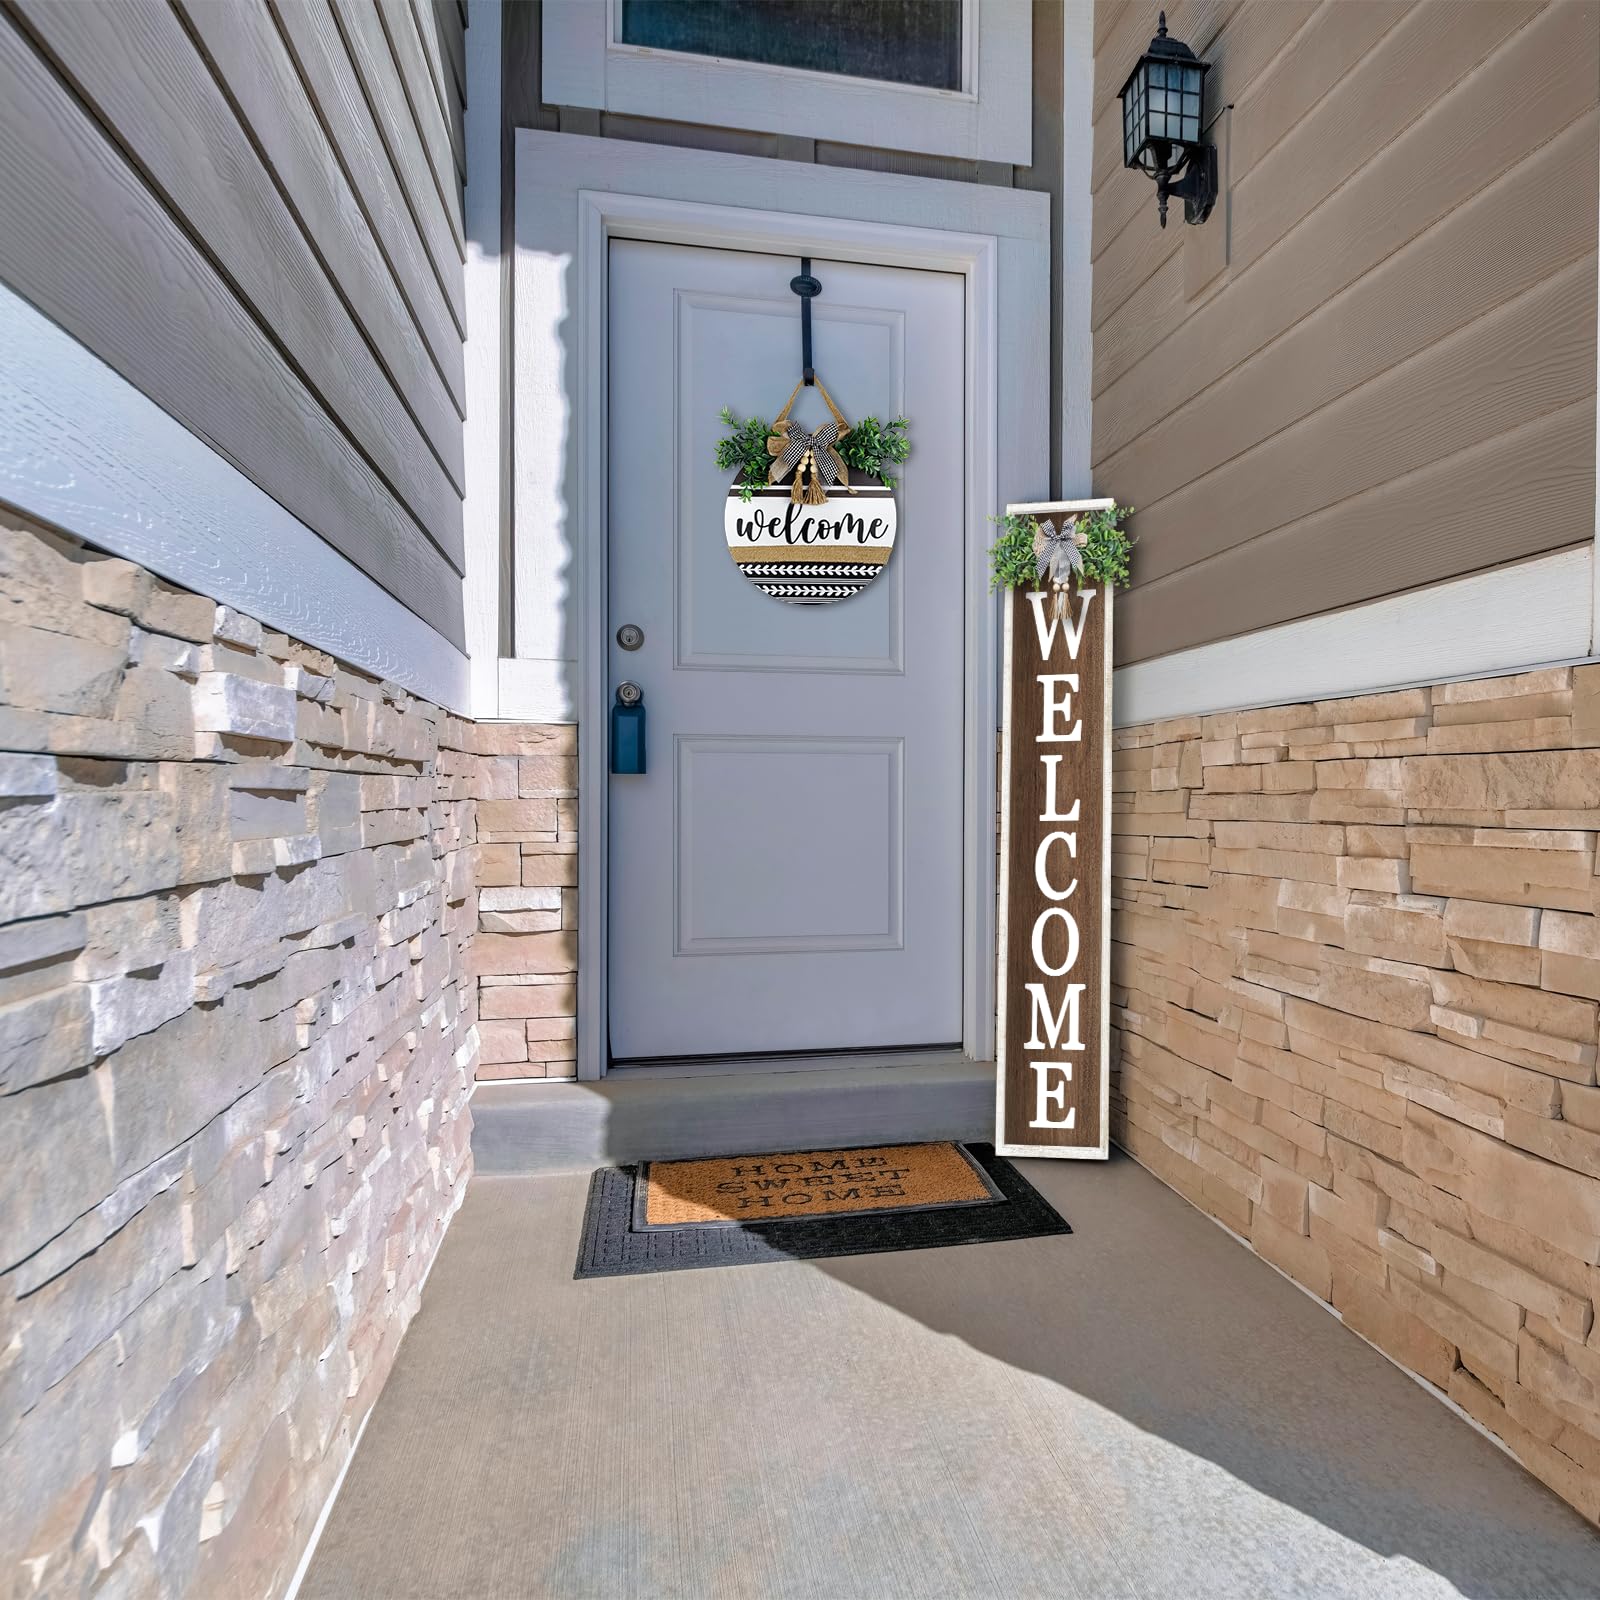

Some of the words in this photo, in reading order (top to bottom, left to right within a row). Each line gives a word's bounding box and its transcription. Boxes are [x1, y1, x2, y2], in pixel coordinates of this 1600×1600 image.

[736, 503, 888, 544] welcome
[1023, 589, 1096, 1129] WELCOME
[731, 1157, 887, 1177] HOME
[716, 1168, 910, 1194] SWEET
[736, 1184, 906, 1208] HOME
